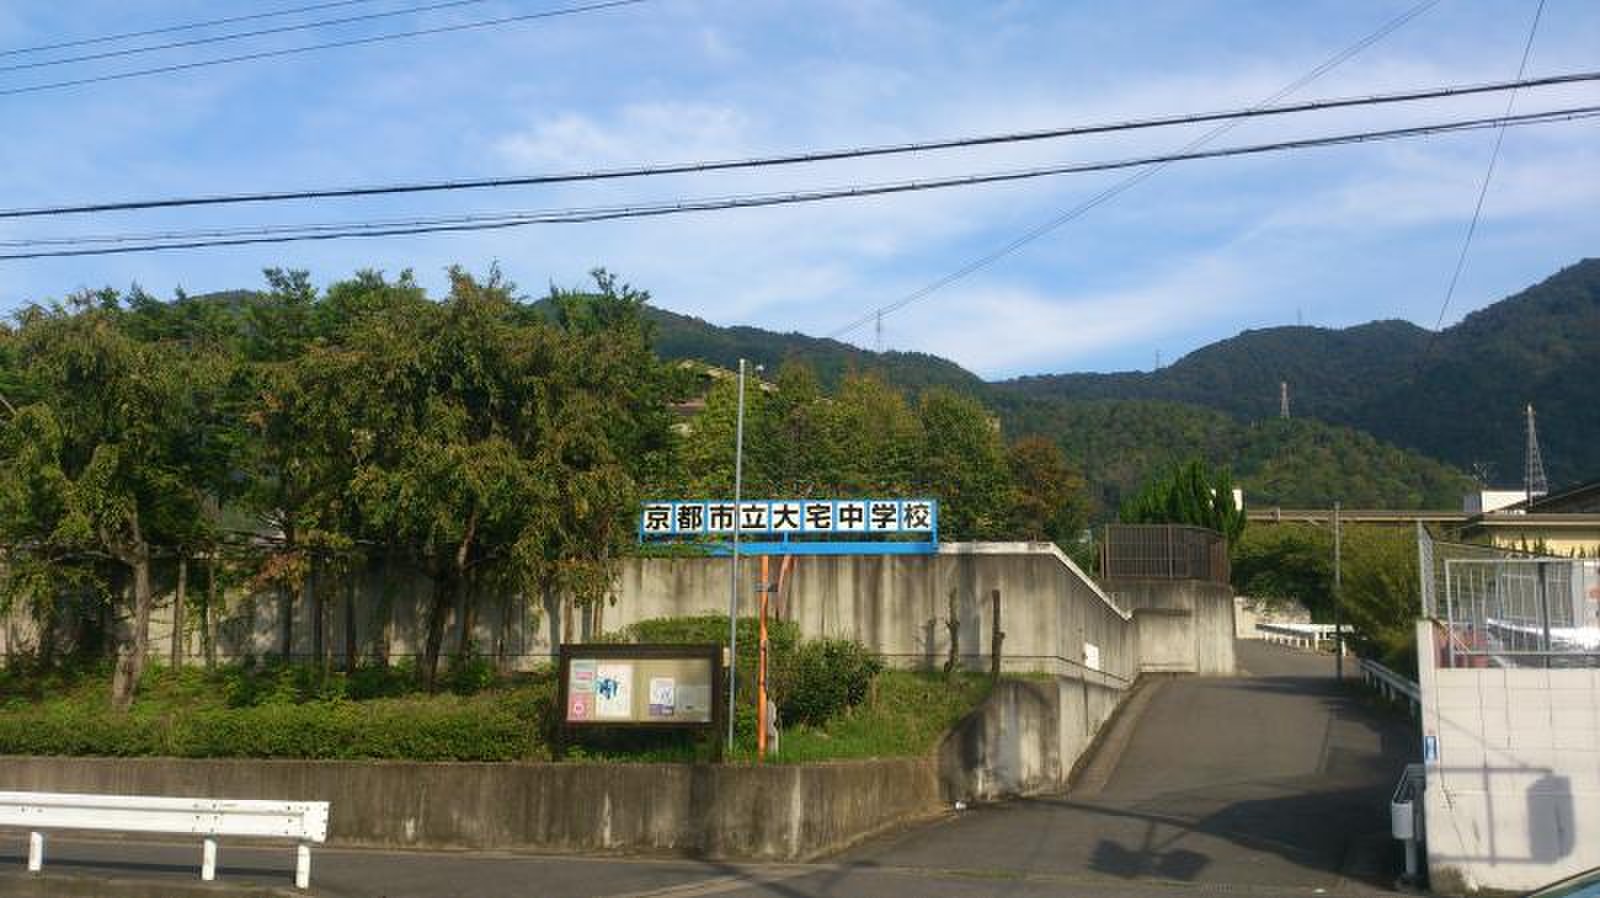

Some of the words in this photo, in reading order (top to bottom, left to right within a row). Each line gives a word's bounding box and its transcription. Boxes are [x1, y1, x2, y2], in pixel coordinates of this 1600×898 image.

[645, 504, 929, 529] 京都市立大宅中学校
